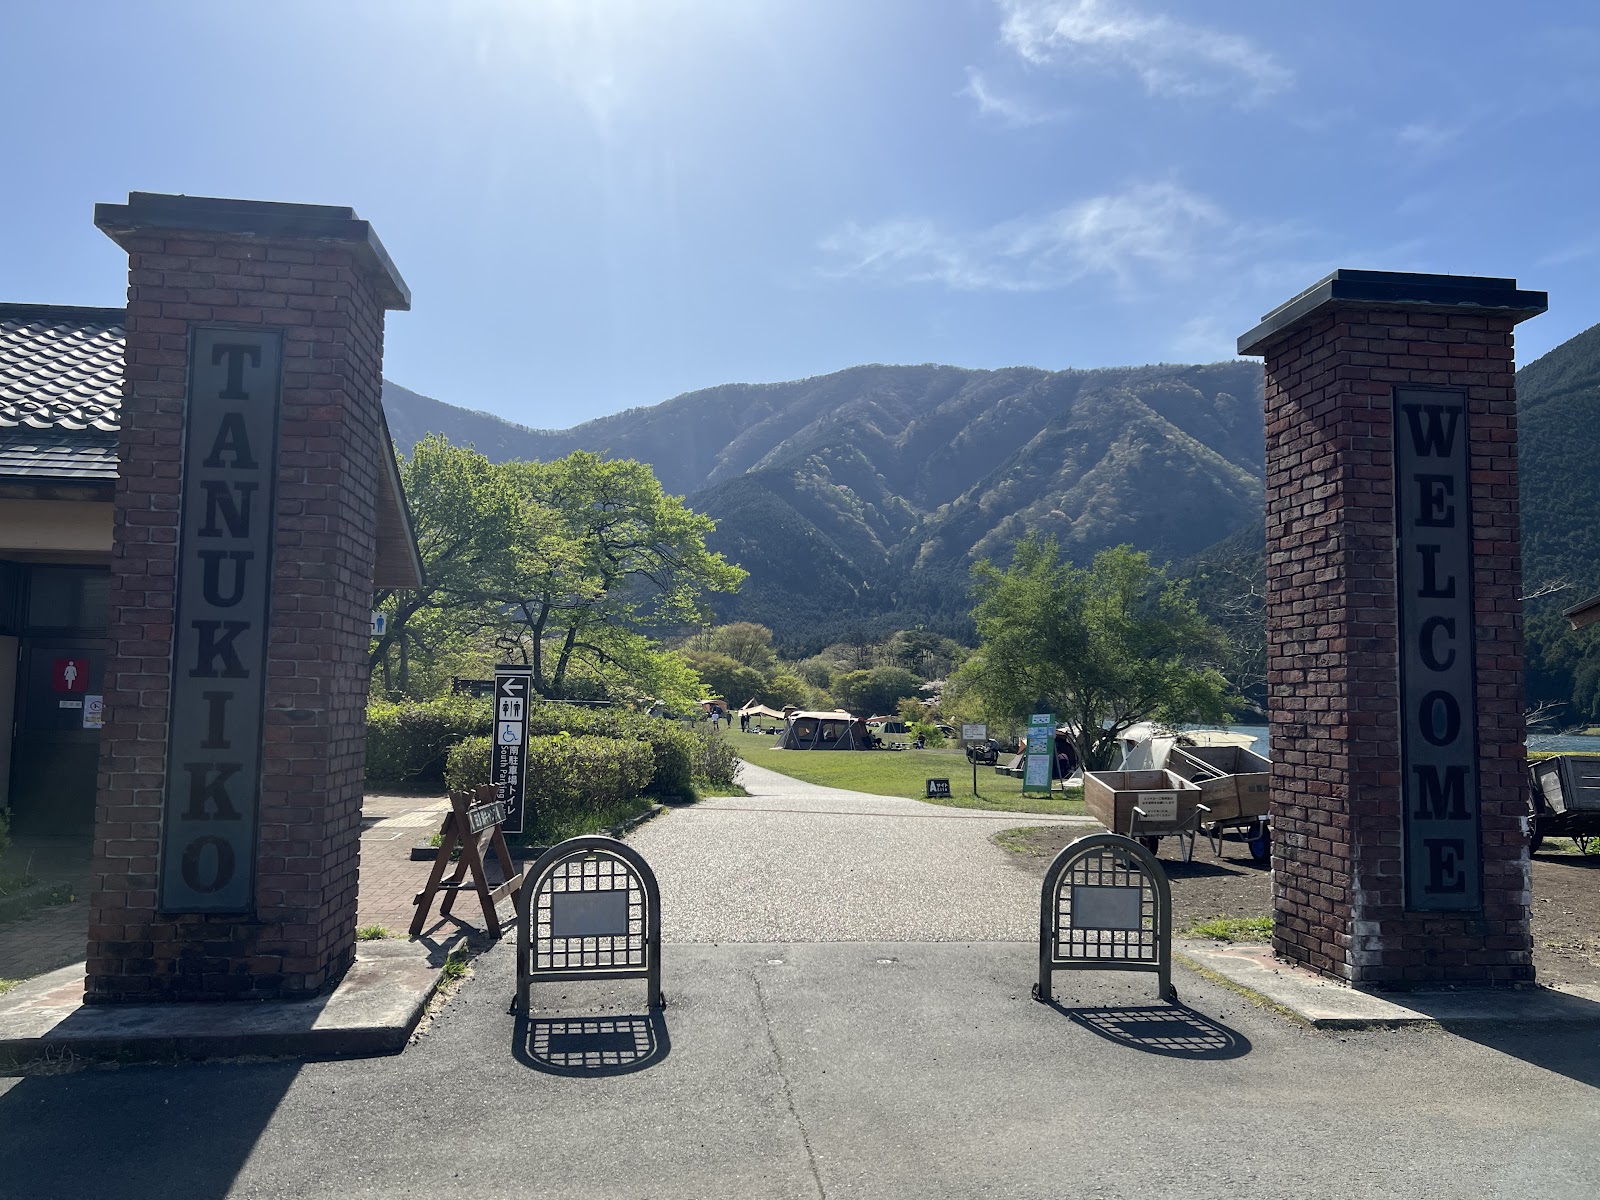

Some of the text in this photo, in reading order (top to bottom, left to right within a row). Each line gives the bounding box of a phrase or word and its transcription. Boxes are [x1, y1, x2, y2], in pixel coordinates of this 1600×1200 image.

[181, 343, 262, 894] TANUKIKO
[507, 745, 519, 815] 南駐車場トイレ
[1401, 404, 1472, 895] WELCOME
